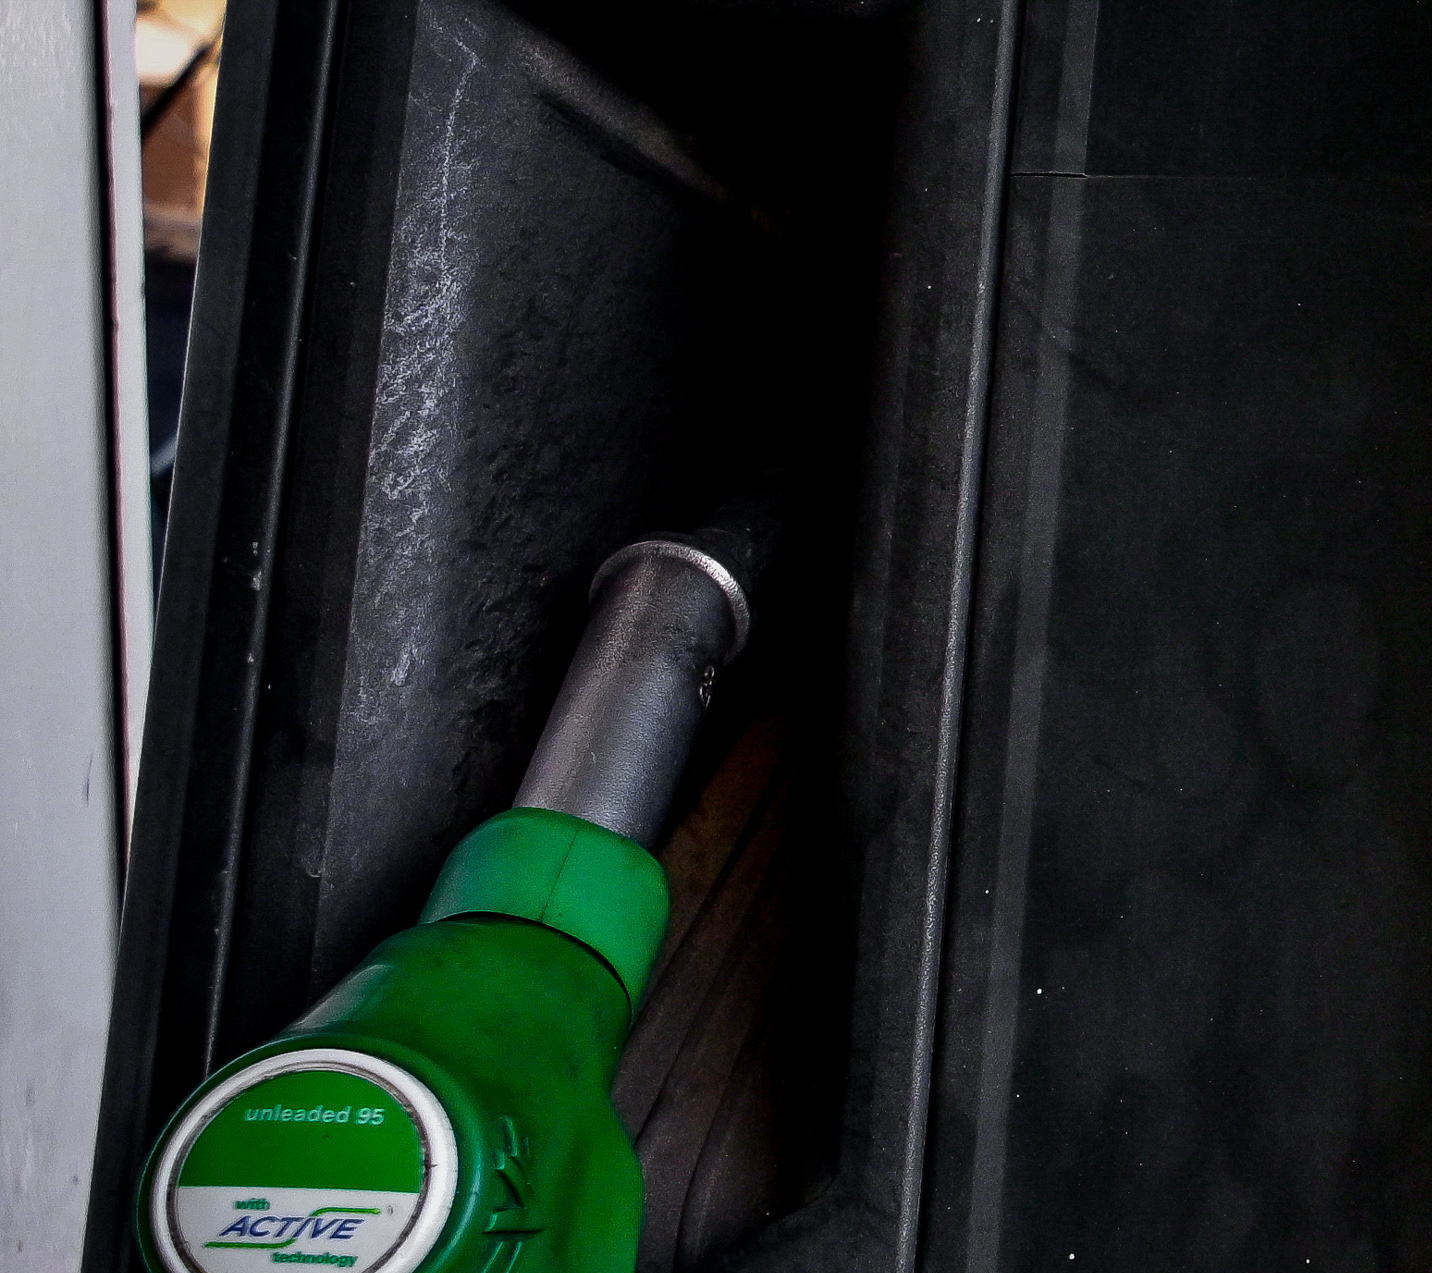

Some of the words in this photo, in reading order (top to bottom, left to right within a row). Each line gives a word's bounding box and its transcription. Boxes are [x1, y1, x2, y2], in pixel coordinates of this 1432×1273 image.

[244, 1104, 351, 1124] unleaded
[357, 1107, 386, 1126] 95
[219, 1216, 365, 1239] ACTIVE
